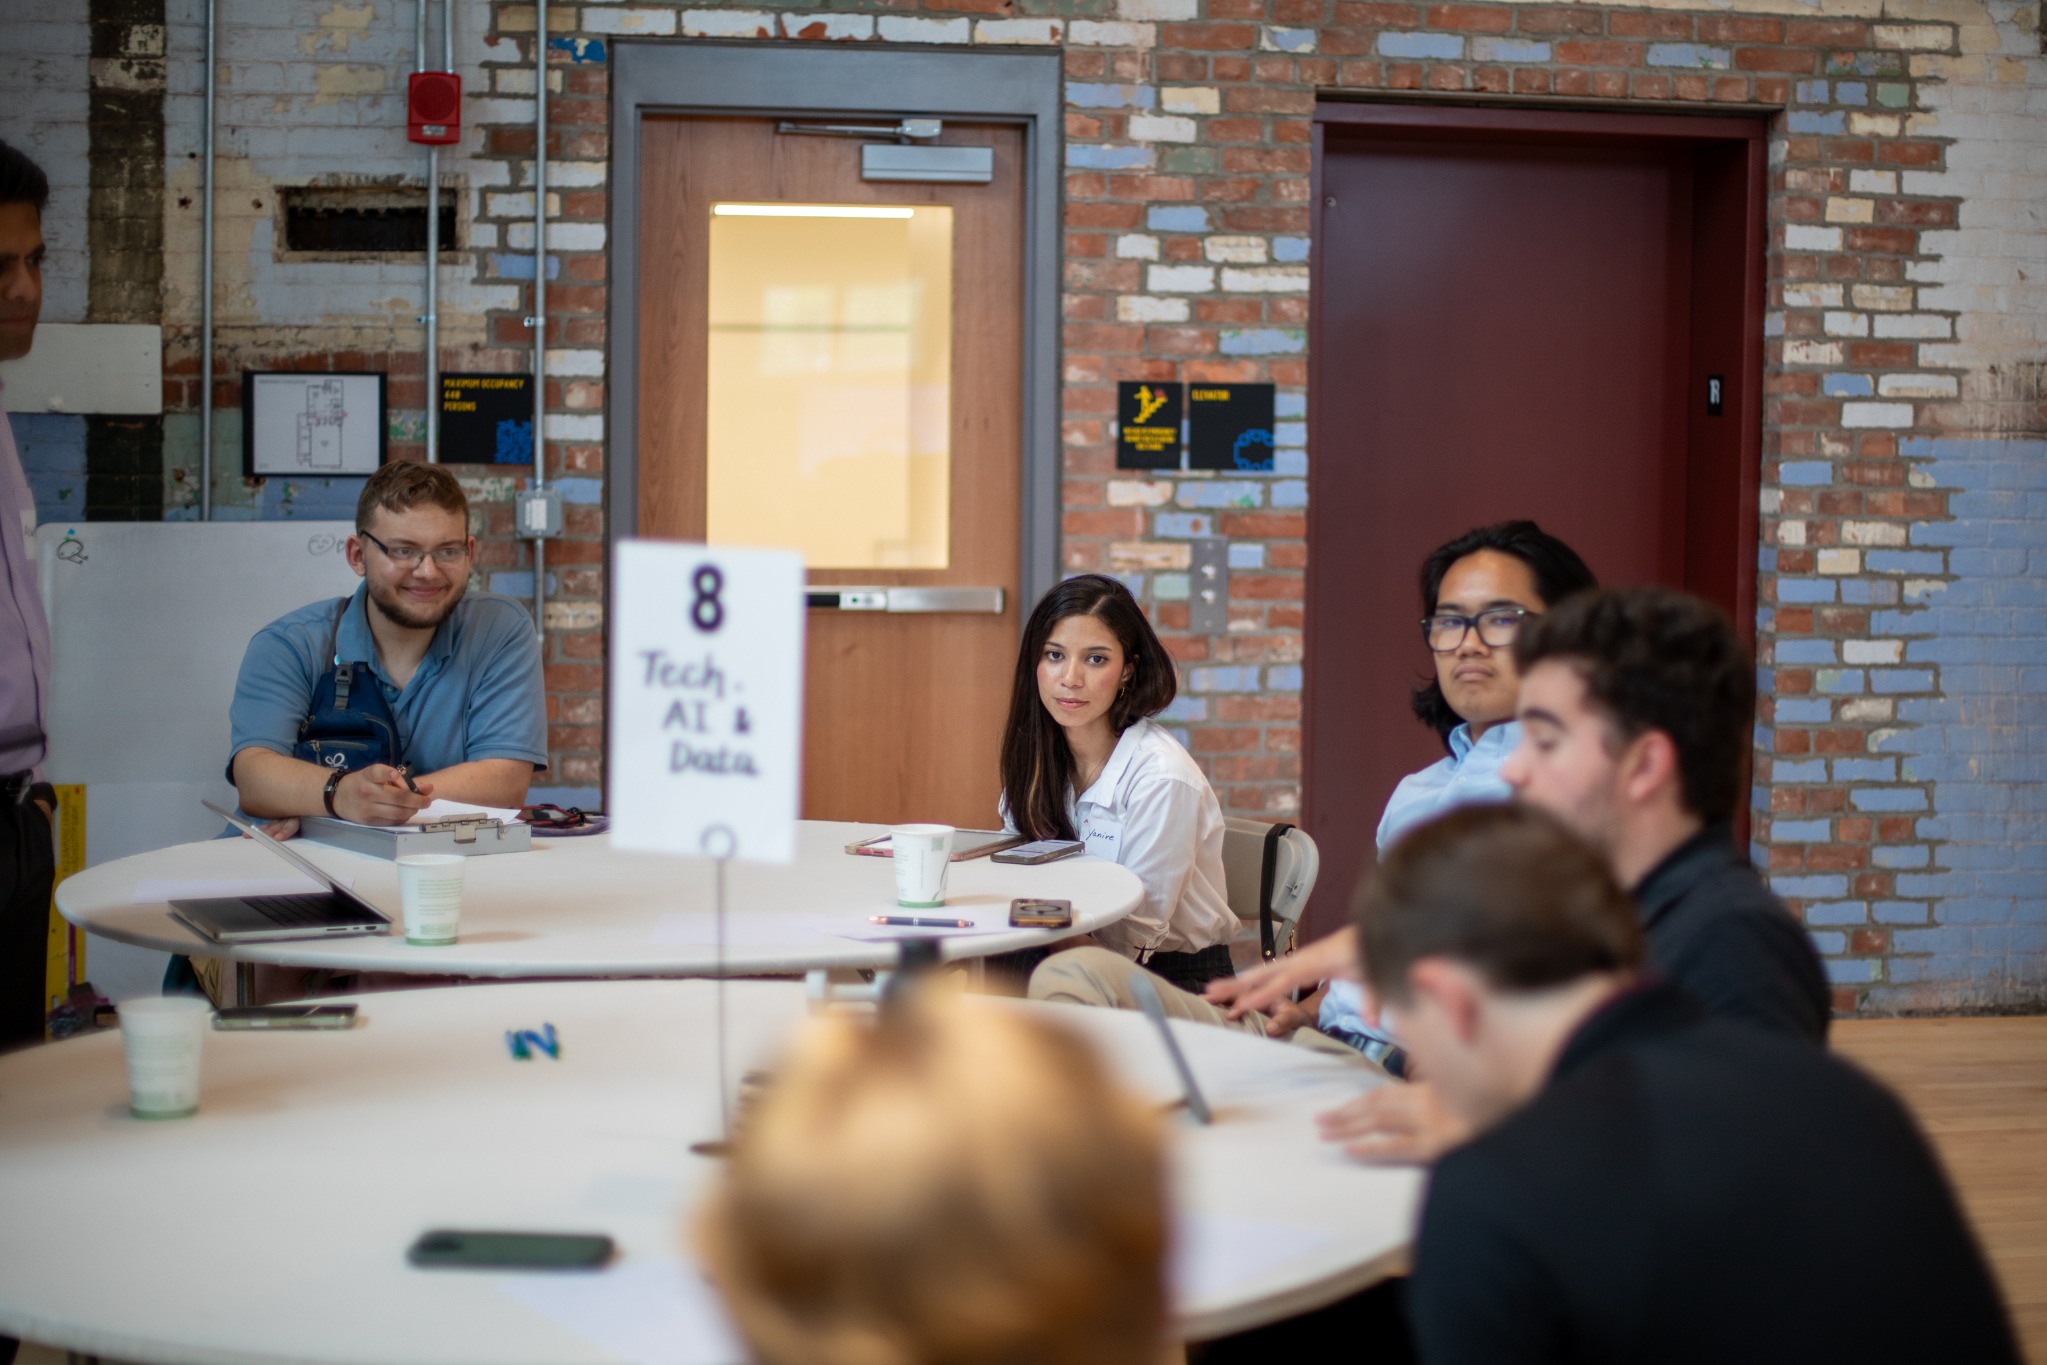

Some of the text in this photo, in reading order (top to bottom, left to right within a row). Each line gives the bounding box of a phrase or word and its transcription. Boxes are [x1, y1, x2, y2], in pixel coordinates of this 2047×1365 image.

[443, 378, 525, 390] MAXIMUM OCCUPANCY
[1191, 388, 1231, 401] ELEVATOR
[443, 401, 477, 412] PERSONS
[690, 564, 725, 634] 8
[662, 699, 752, 734] AI &
[668, 740, 762, 777] Data
